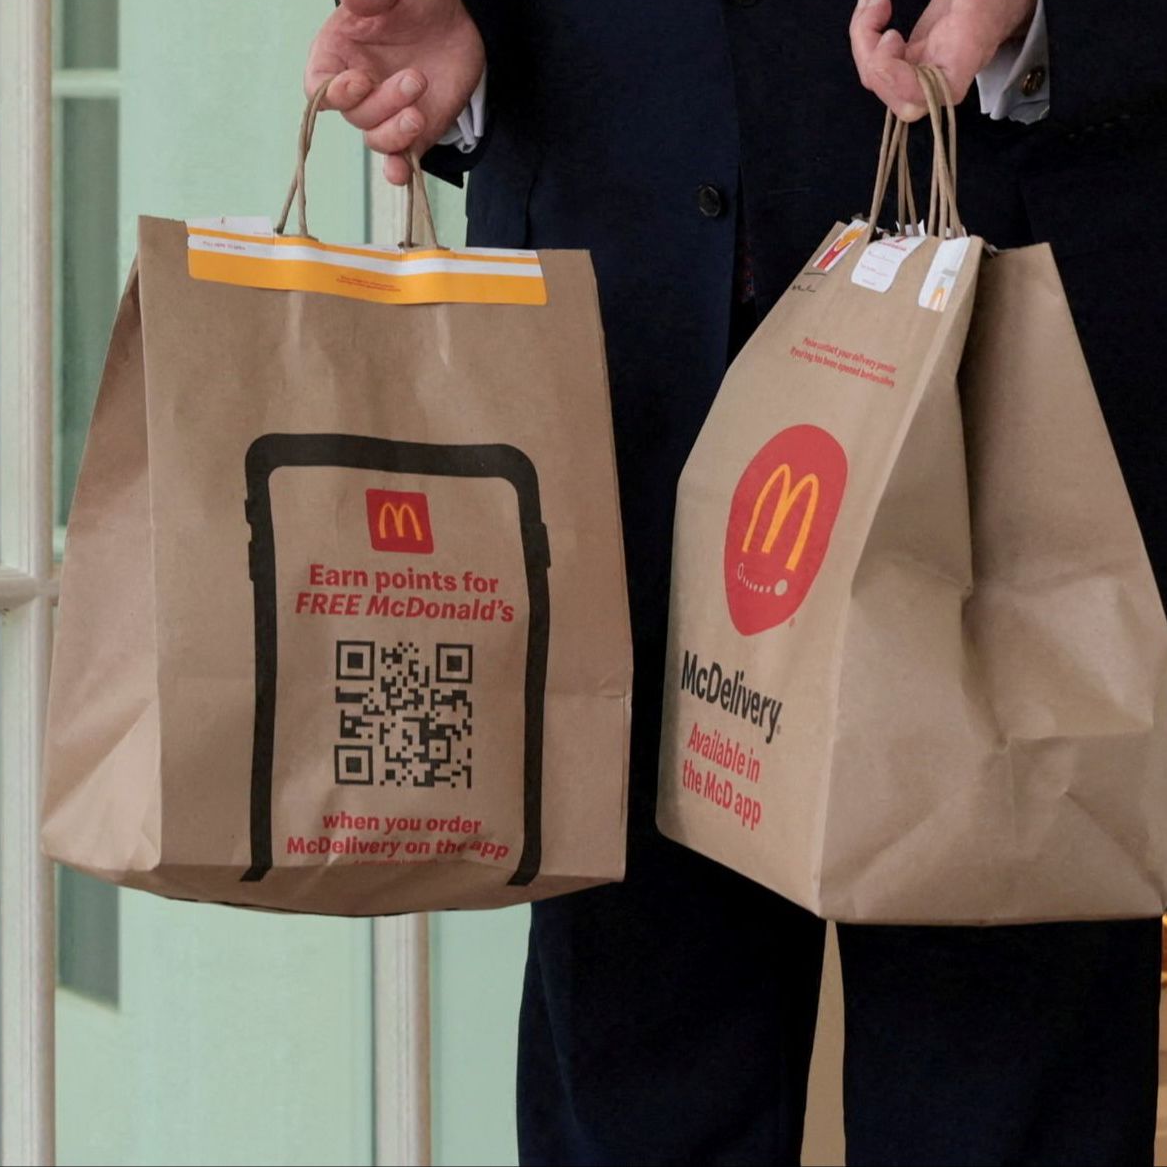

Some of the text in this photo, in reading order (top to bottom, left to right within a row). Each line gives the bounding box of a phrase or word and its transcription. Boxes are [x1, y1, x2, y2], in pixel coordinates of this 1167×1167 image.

[310, 564, 499, 594] Earn points for
[295, 592, 514, 622] FREE McDonald's
[681, 650, 783, 744] McDelivery
[688, 722, 760, 783] Available in
[683, 759, 761, 831] the McD app
[322, 811, 482, 835] when you order
[287, 836, 510, 860] McDelivery on the app
